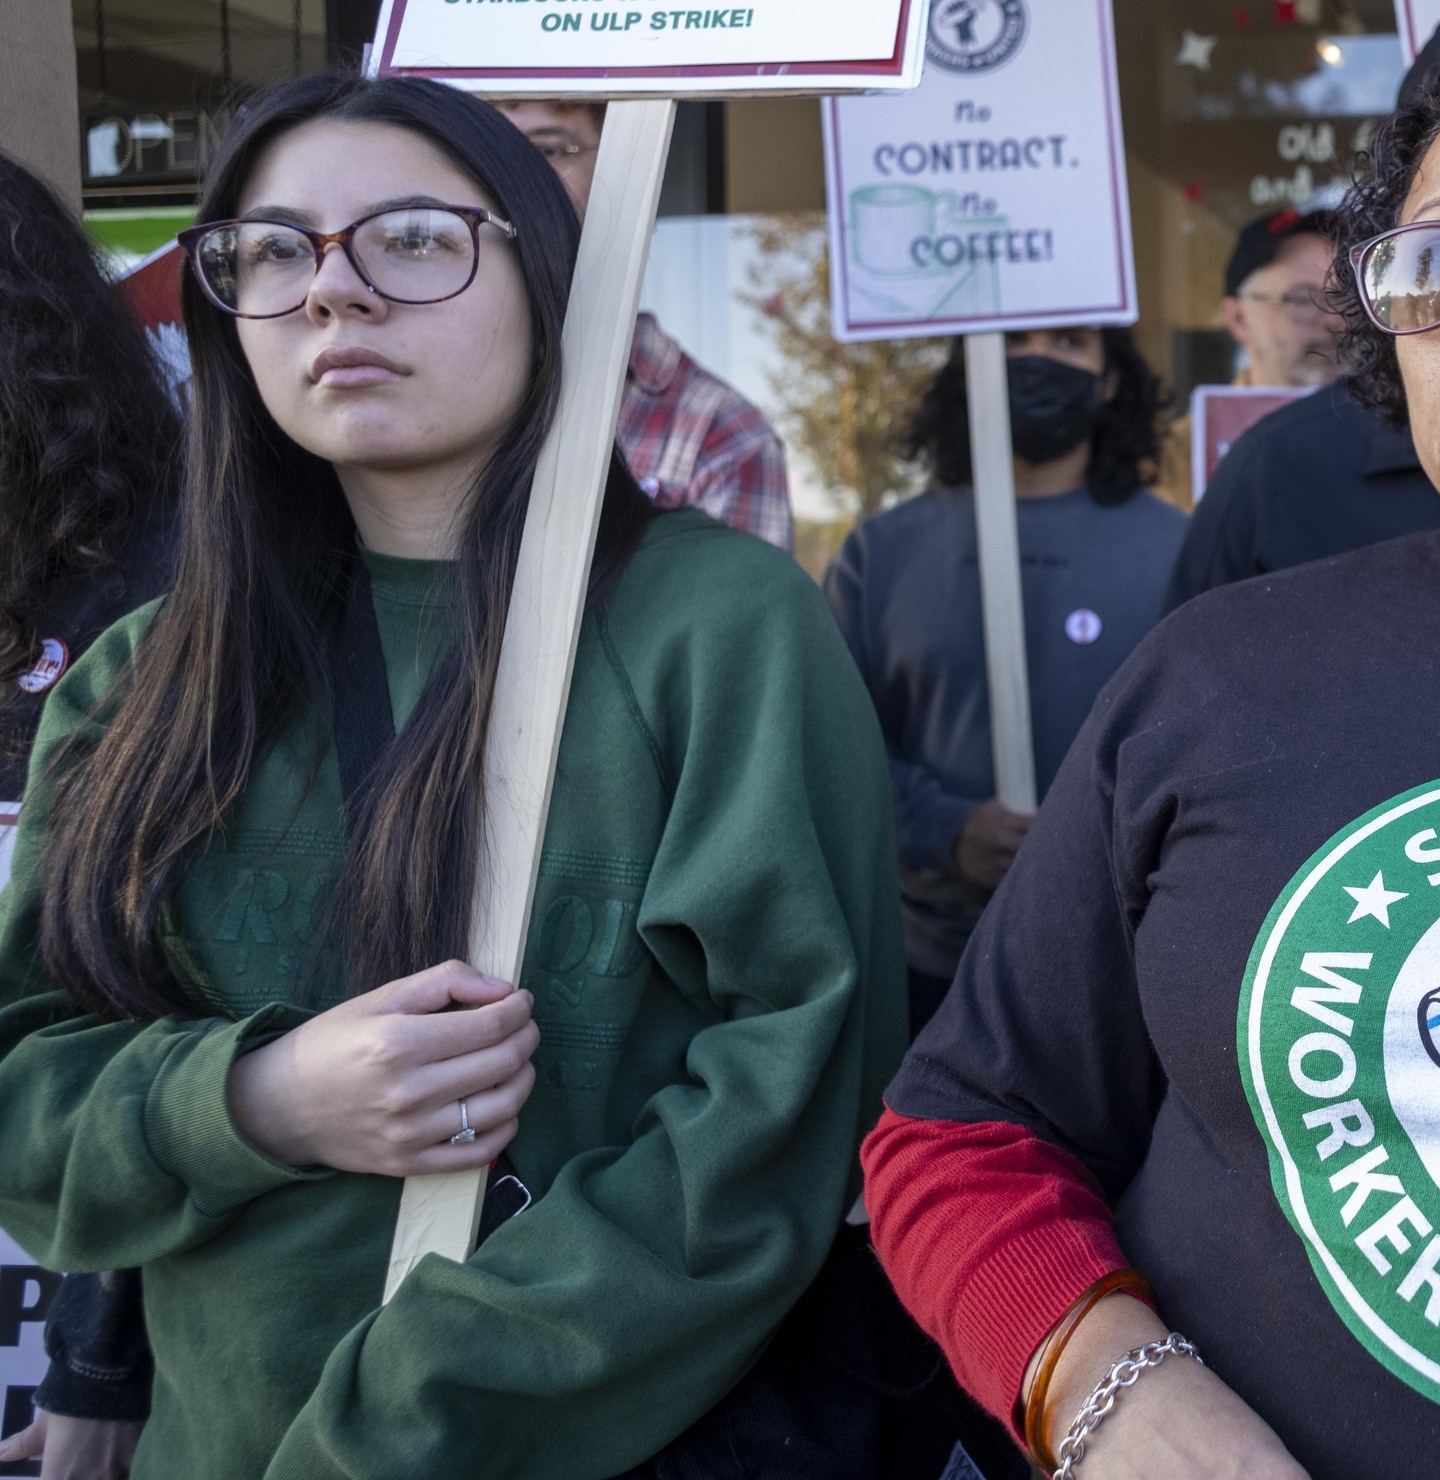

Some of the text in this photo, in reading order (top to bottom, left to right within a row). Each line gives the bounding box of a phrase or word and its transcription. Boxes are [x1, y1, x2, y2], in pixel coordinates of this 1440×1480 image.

[541, 9, 754, 32] ON ULP STRIKE!
[873, 135, 1080, 177] CONTRACT.
[910, 229, 1054, 268] COFFEE!
